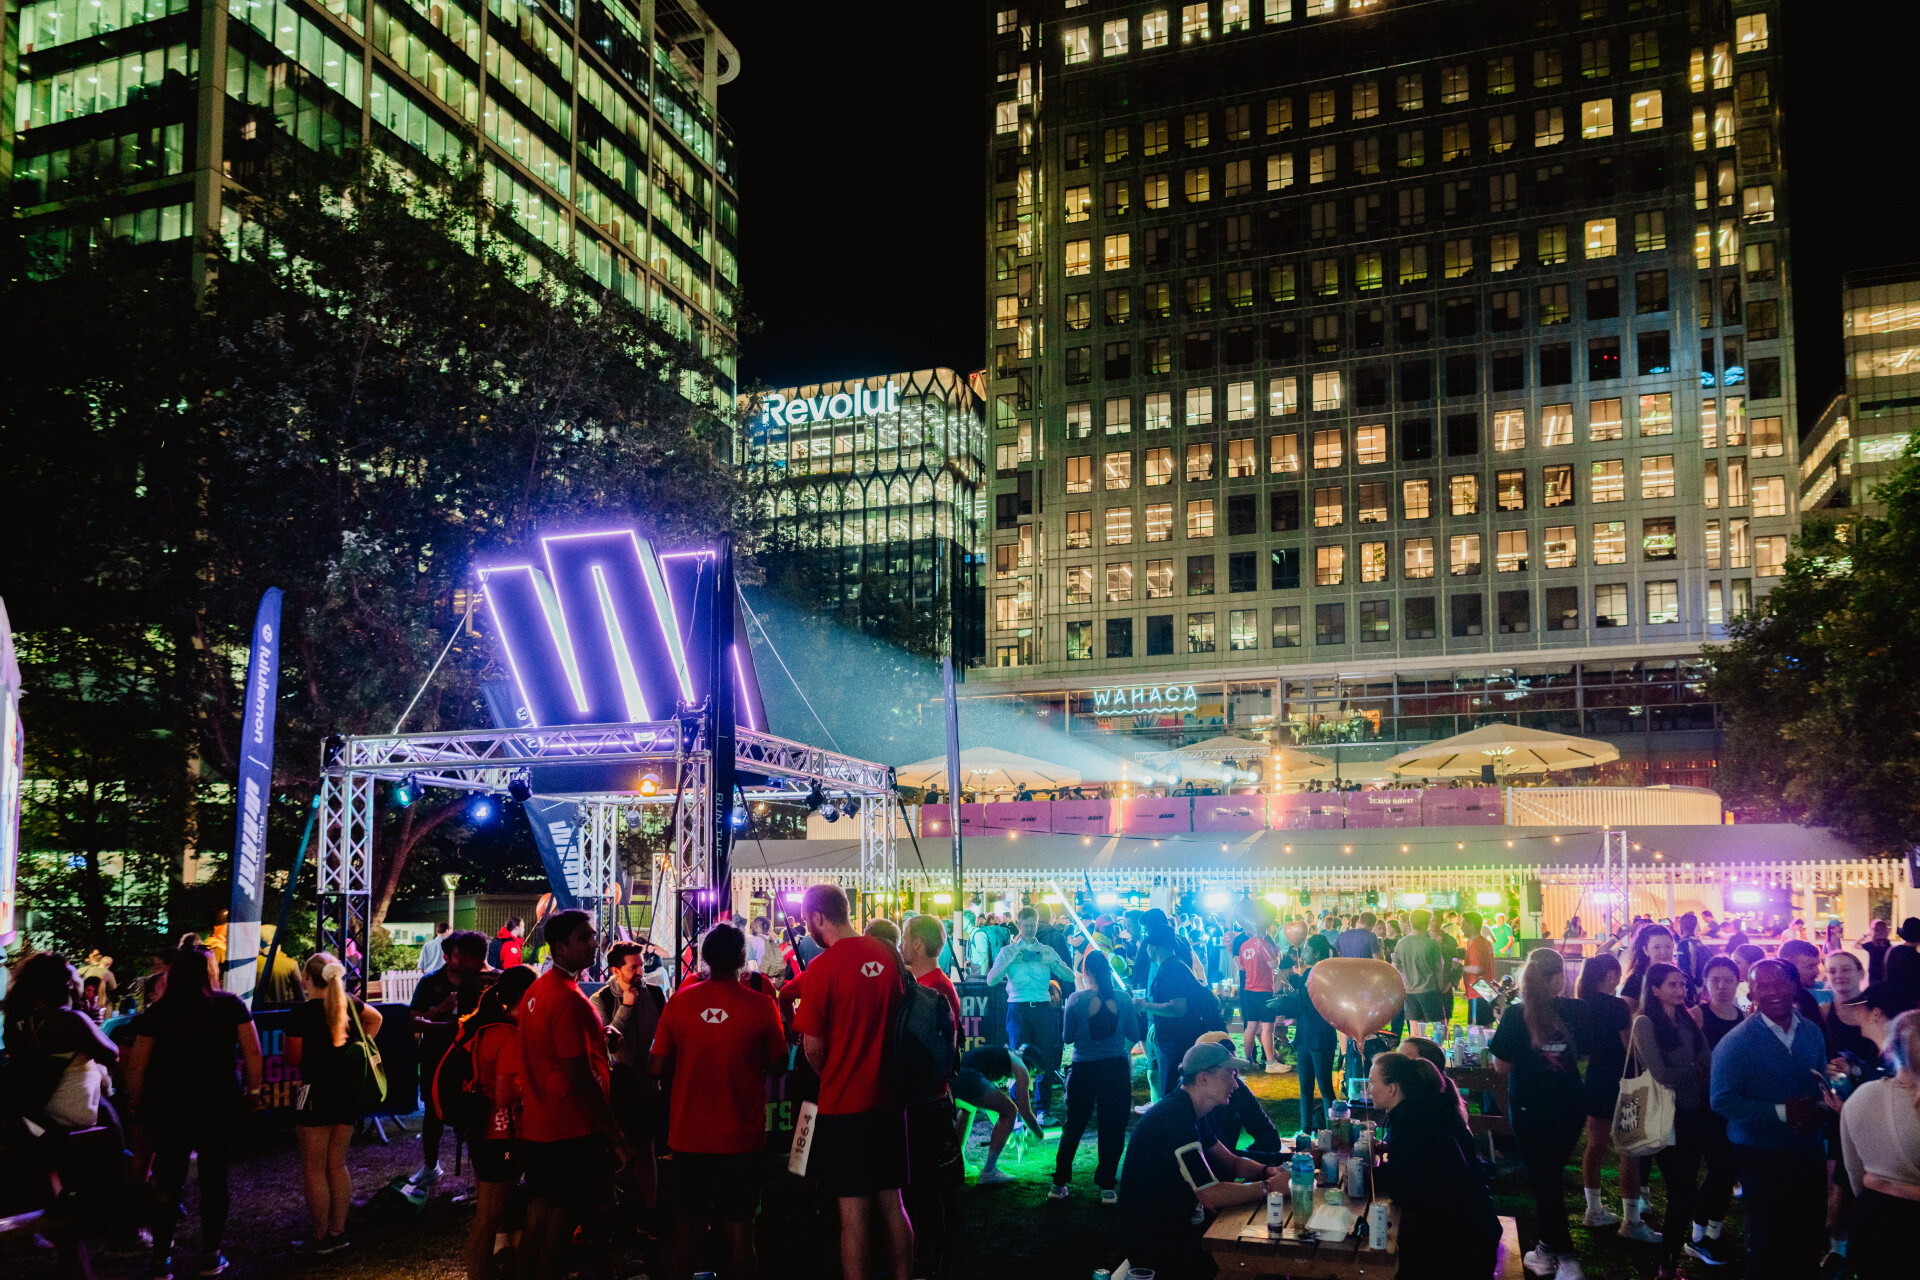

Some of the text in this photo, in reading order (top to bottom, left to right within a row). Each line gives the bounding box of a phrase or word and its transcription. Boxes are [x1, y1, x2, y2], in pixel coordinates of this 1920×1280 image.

[761, 380, 901, 426] Revolut
[253, 645, 272, 744] lululemon
[1093, 684, 1198, 706] WAHACA
